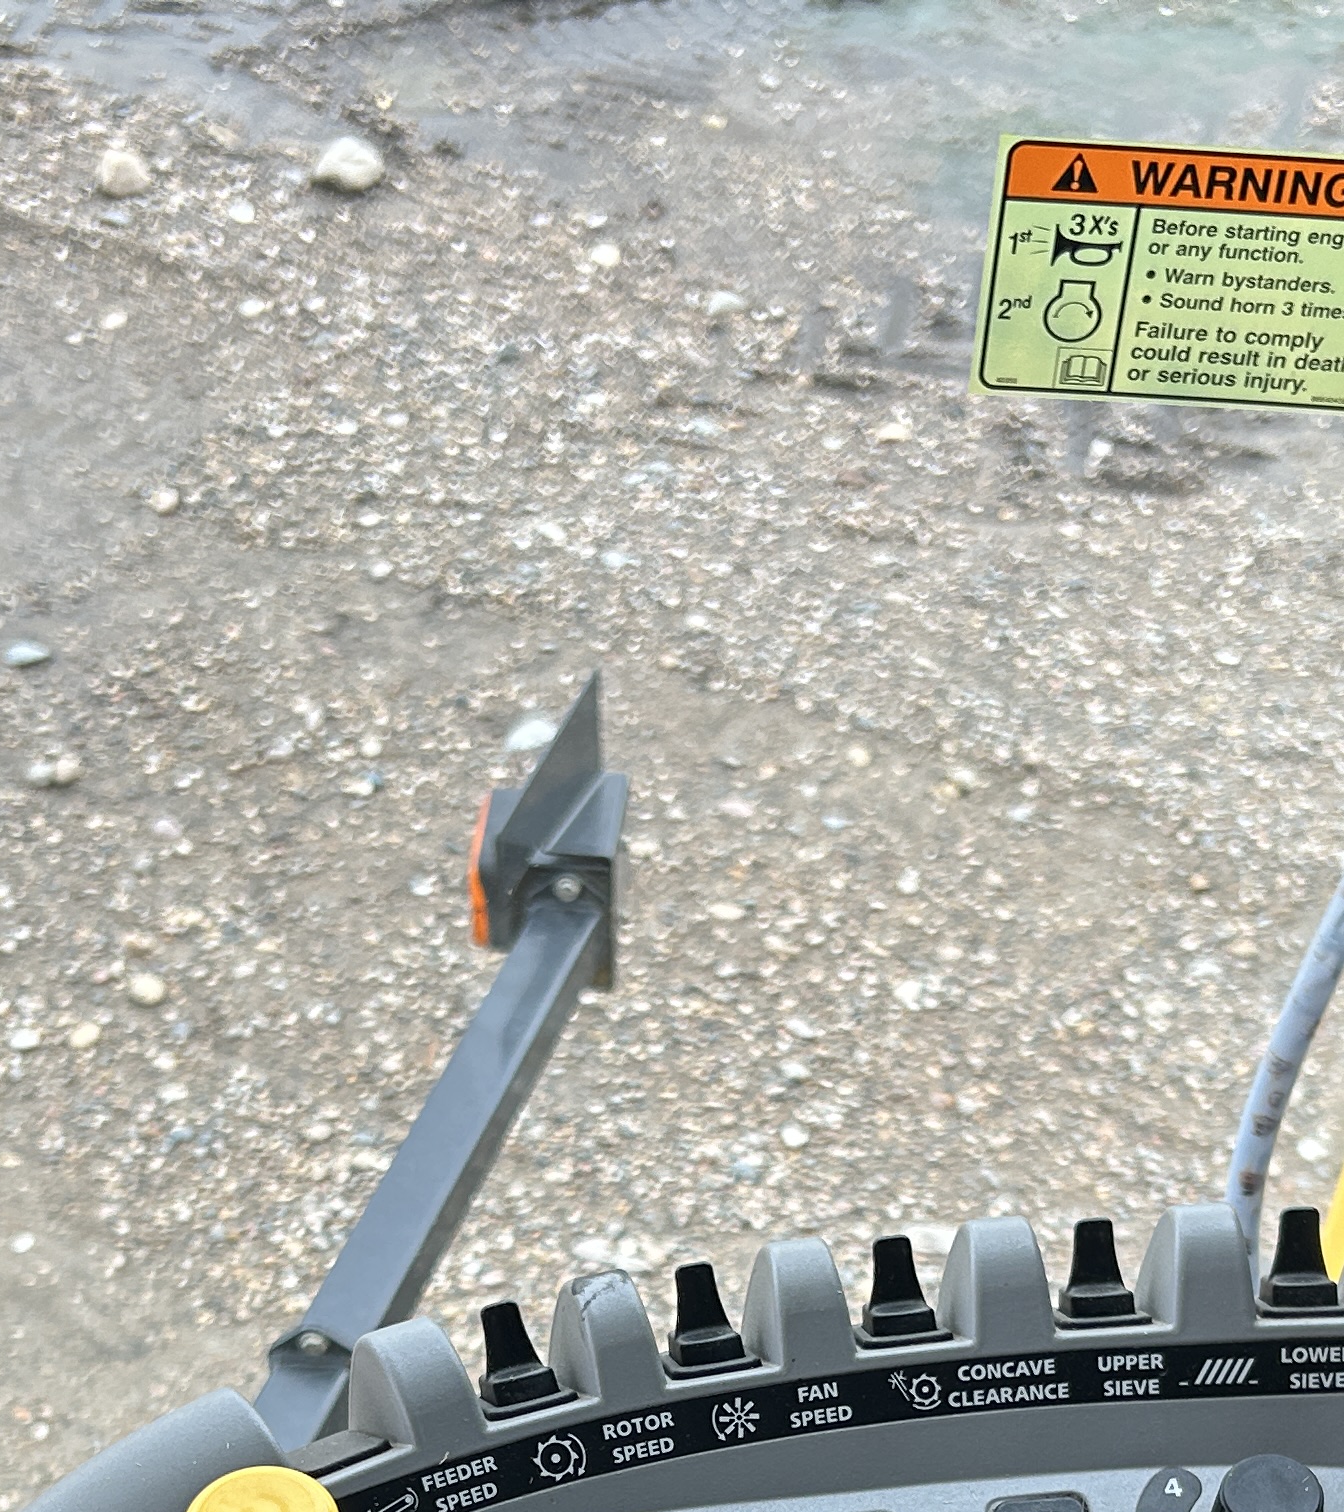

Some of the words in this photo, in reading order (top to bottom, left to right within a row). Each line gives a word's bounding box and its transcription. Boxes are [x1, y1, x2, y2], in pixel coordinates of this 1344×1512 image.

[1008, 229, 1033, 255] 1st
[1152, 218, 1217, 238] Before
[1224, 223, 1301, 246] starting
[1148, 242, 1169, 255] or
[1175, 243, 1213, 262] any
[1218, 243, 1304, 264] function.
[1165, 268, 1214, 286] Warn
[1221, 271, 1336, 294] bystanders.
[997, 294, 1033, 320] 2nd
[1159, 292, 1224, 311] Sound
[1230, 297, 1275, 316] horn
[1281, 301, 1295, 317] 3
[1135, 320, 1208, 342] Failure
[1215, 326, 1237, 344] to
[1244, 331, 1325, 353] comply
[1130, 345, 1192, 363] could
[1198, 349, 1261, 367] result
[1266, 351, 1287, 369] in
[1127, 368, 1151, 382] or
[1156, 368, 1237, 387] serious
[1243, 372, 1308, 396] injury.
[957, 1358, 1056, 1382] CONCAVE
[1097, 1354, 1164, 1373] UPPER
[797, 1381, 839, 1404] FAN
[948, 1382, 1070, 1408] CLEARANCE
[1103, 1378, 1160, 1397] SIEVE
[602, 1411, 675, 1441] ROTOR
[790, 1405, 853, 1429] SPEED
[612, 1437, 675, 1465] SPEED
[421, 1455, 498, 1493] FEEDER
[1164, 1477, 1183, 1497] 4
